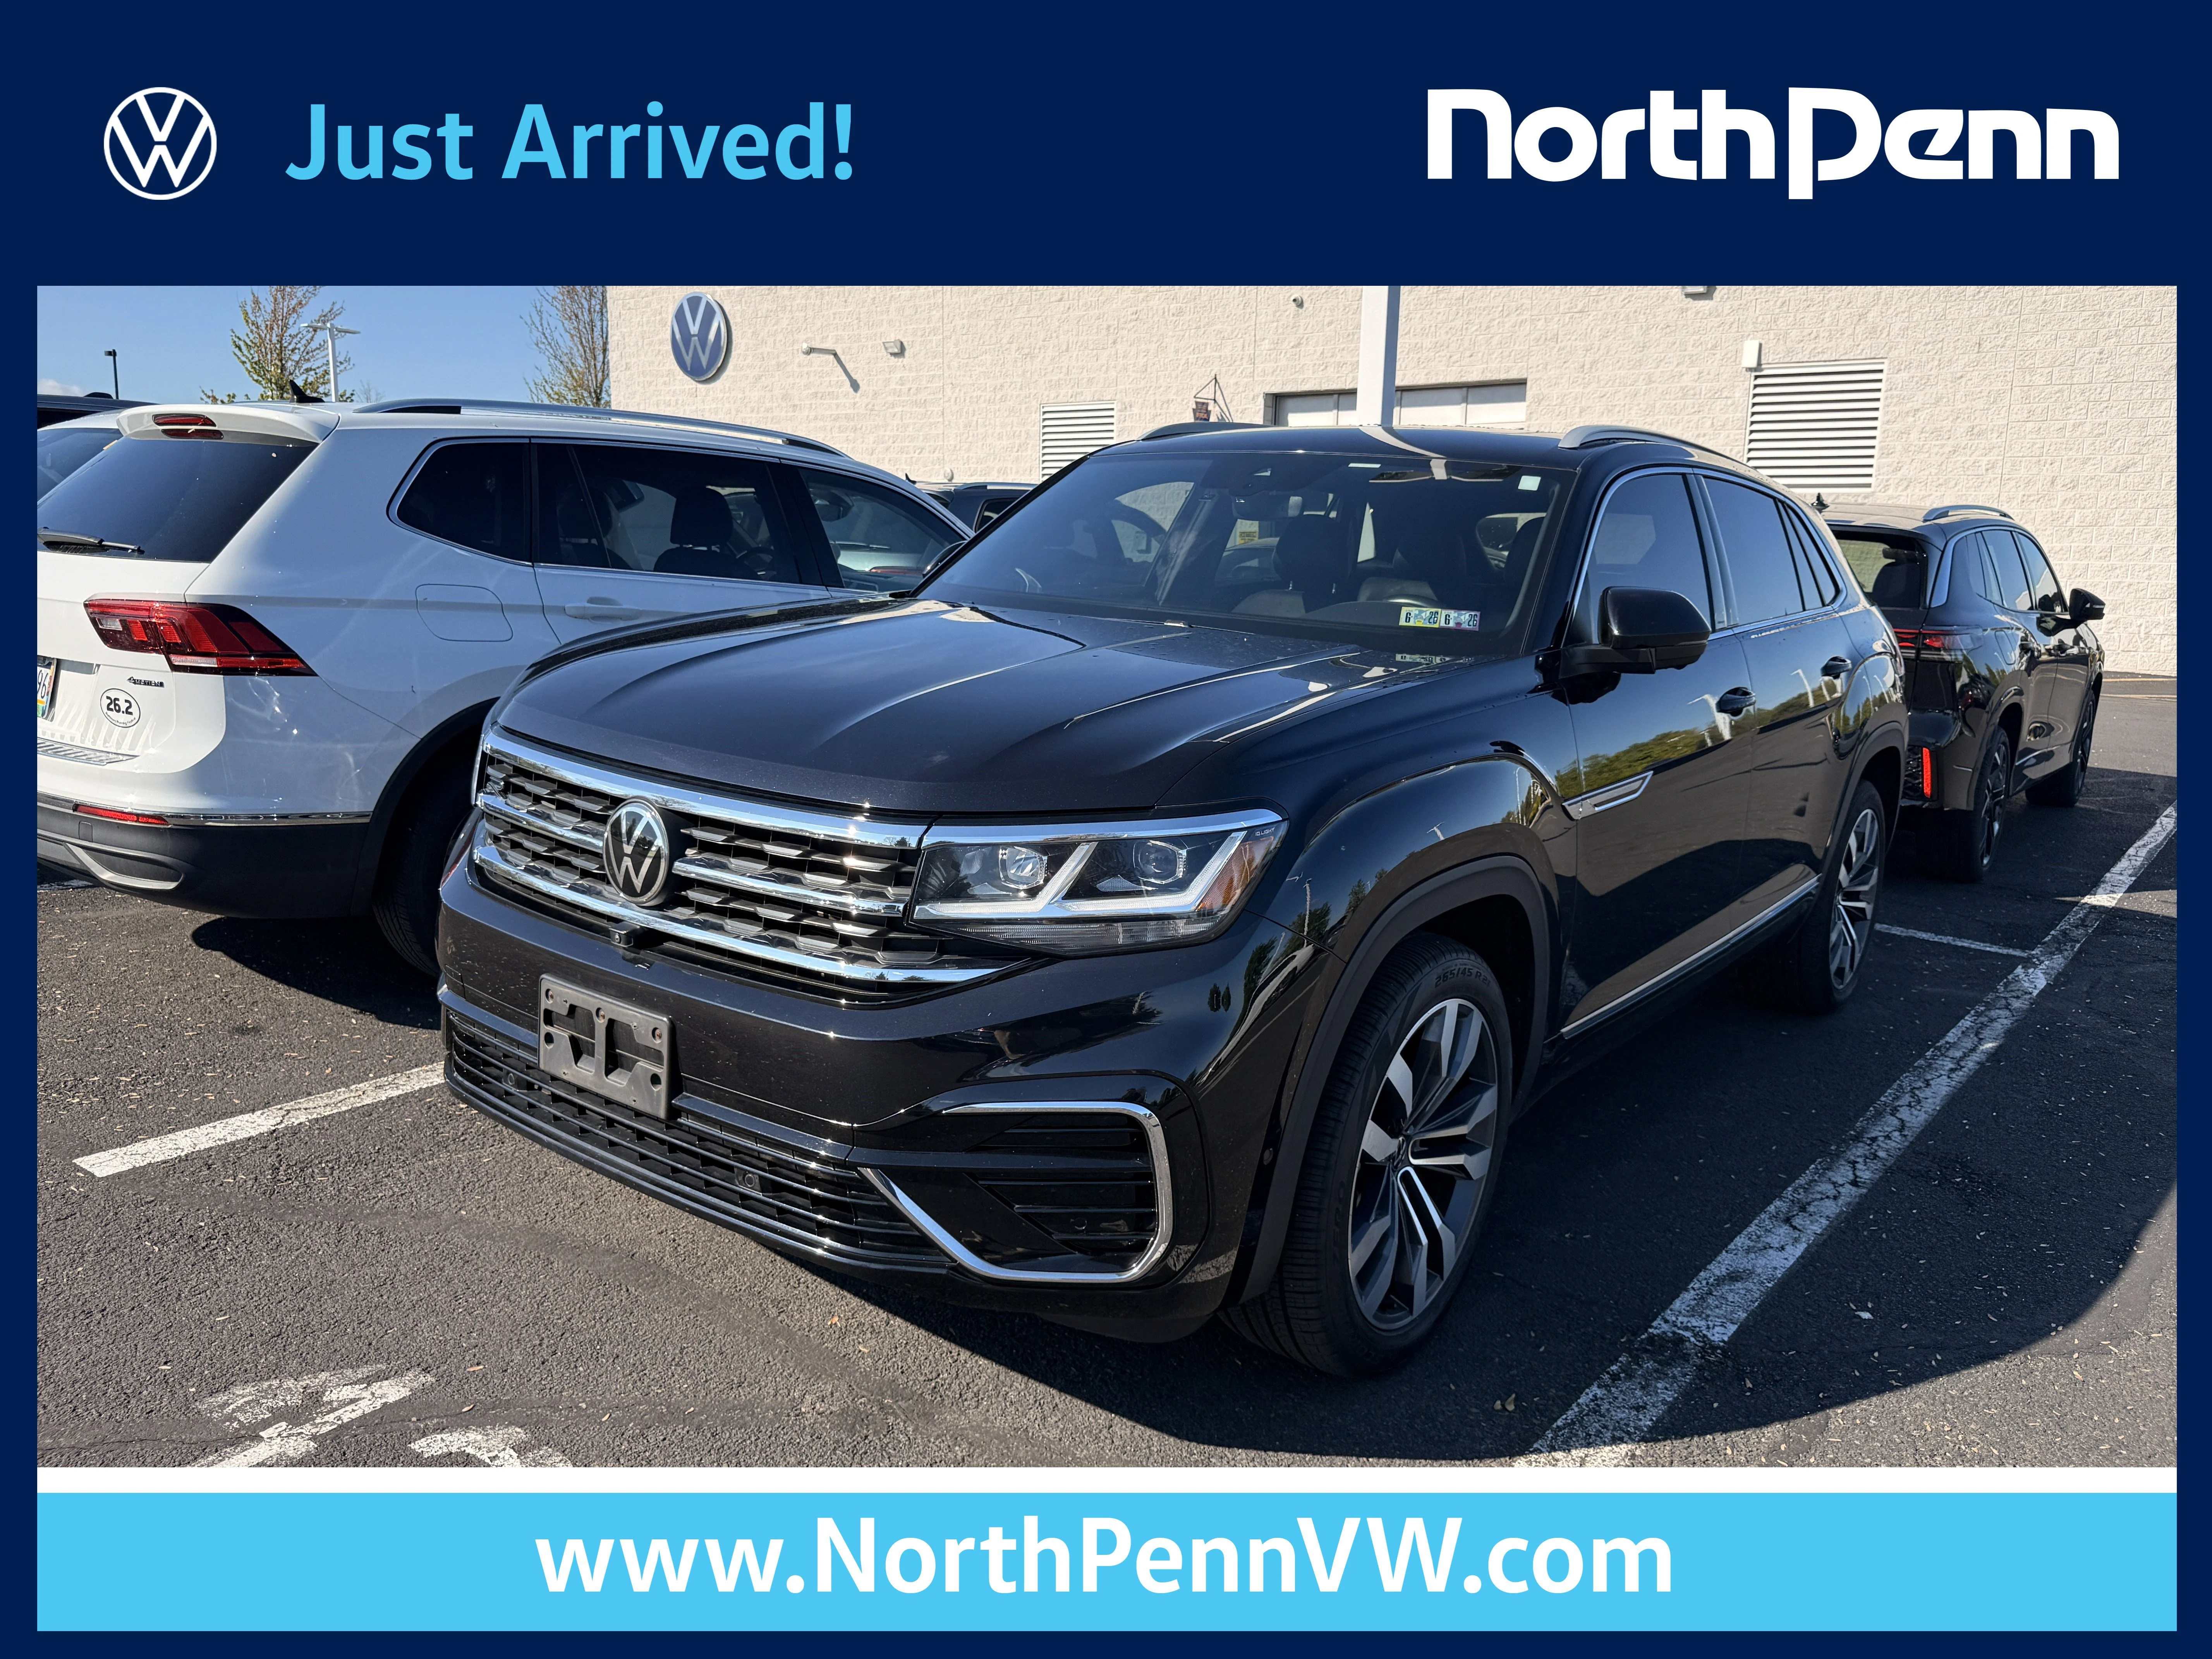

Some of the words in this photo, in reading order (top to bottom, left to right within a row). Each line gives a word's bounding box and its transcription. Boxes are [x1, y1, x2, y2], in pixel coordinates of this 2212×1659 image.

[1428, 611, 1438, 624] 26
[1468, 614, 1477, 627] 26
[106, 696, 133, 716] 26.2
[1435, 967, 1473, 988] 265/45
